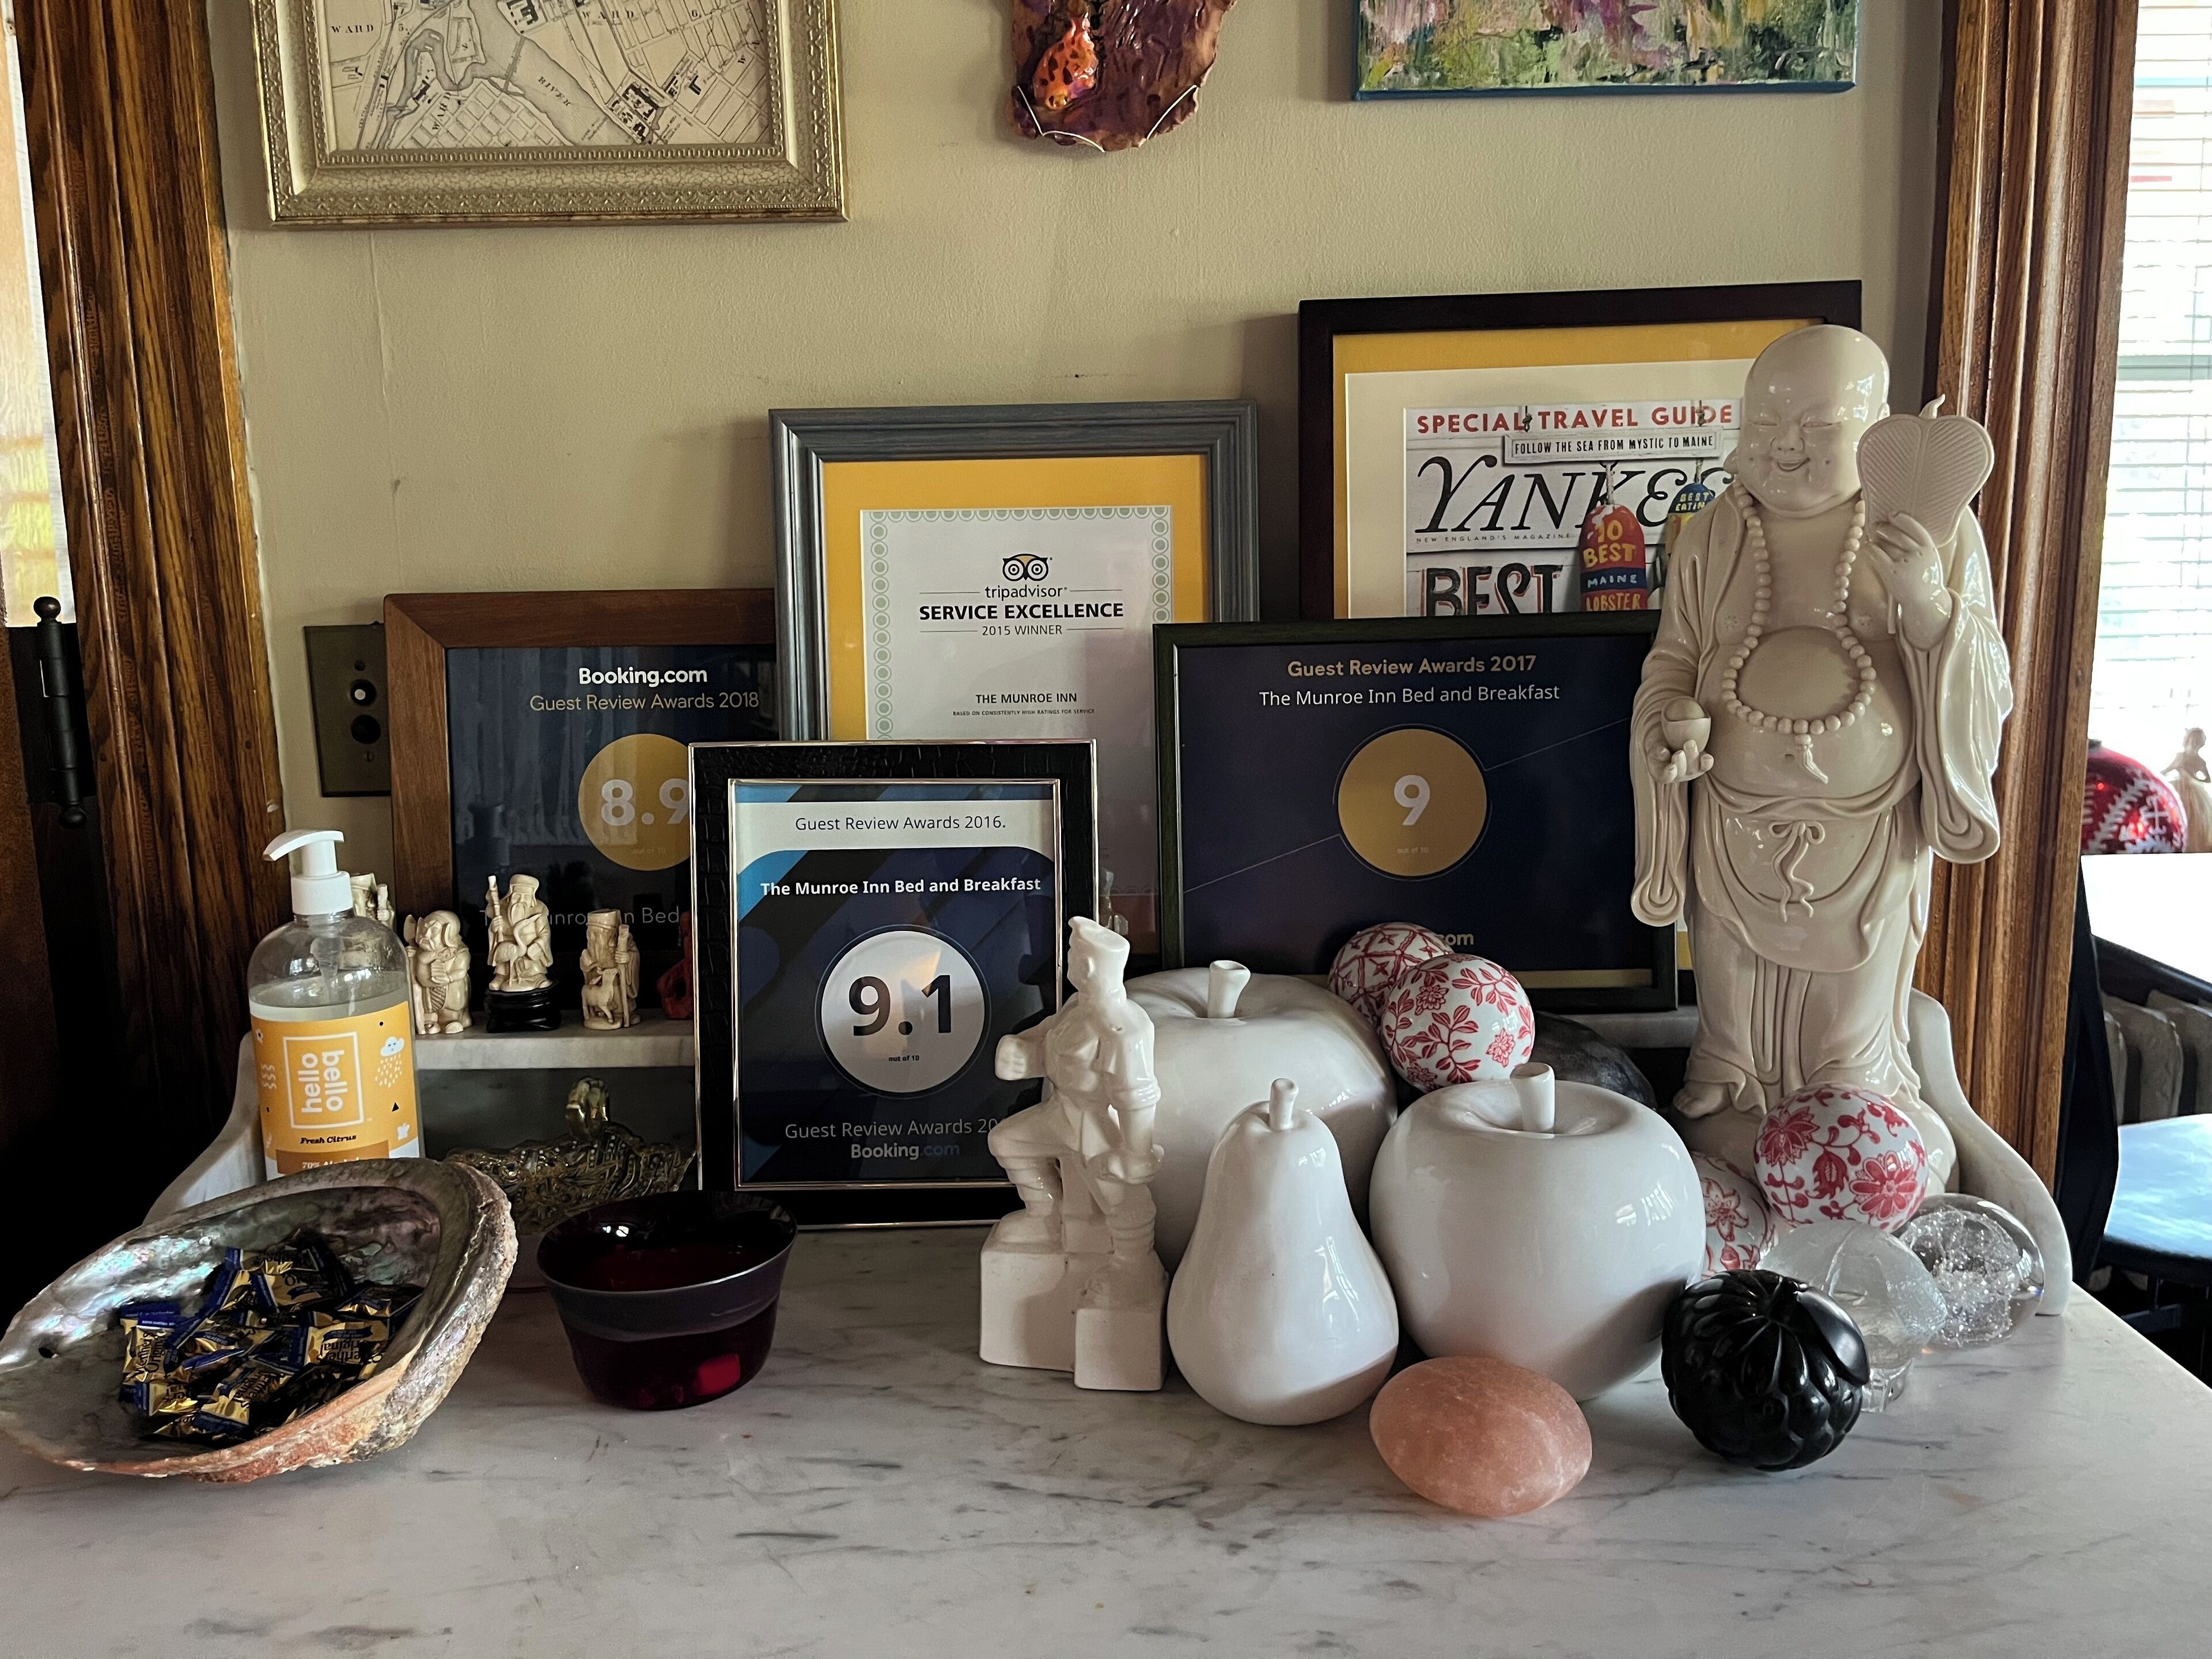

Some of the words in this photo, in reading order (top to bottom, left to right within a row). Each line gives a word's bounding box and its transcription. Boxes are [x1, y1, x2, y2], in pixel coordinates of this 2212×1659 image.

[331, 24, 374, 33] WARD
[537, 76, 572, 107] RIVER
[432, 92, 452, 130] WARD
[1417, 411, 1525, 434] SPECIAL
[1538, 408, 1638, 429] TRAVEL
[1651, 404, 1732, 426] GUIDE
[1515, 442, 1551, 454] FOLLOW
[1556, 441, 1571, 453] THE
[1577, 440, 1593, 452] SEA
[1598, 439, 1624, 451] FROM
[1628, 438, 1664, 450] MYSTIC
[1669, 437, 1679, 449] TO
[1683, 436, 1713, 448] MAINE
[1680, 492, 1709, 502] BEST
[1675, 502, 1705, 512] EATIN
[1596, 520, 1623, 543] 10
[1583, 543, 1637, 569] BEST
[1421, 563, 1563, 616] BEST
[1587, 574, 1637, 588] MAINE
[985, 585, 1063, 601] tripadvisor
[1586, 593, 1641, 611] LOBSTER
[919, 604, 998, 620] SERVICE
[1005, 603, 1124, 619] EXCELLENCE
[982, 626, 1011, 636] 2015
[1015, 624, 1062, 635] WINNER
[1287, 661, 1343, 677] Guest
[1350, 659, 1413, 675] Review
[1418, 657, 1485, 674] Awards
[1490, 655, 1536, 672] 2017
[579, 666, 707, 687] Booking.com
[530, 695, 581, 711] Guest
[587, 694, 646, 710] Review
[651, 692, 714, 709] Awards
[719, 692, 759, 707] 2018
[976, 694, 997, 703] THE
[1001, 693, 1052, 703] MUNROE
[1056, 693, 1077, 702] INN
[1260, 691, 1290, 707] The
[1296, 690, 1363, 706] Munroe
[1369, 689, 1396, 704] Inn
[1403, 687, 1434, 703] Bed
[1440, 687, 1472, 702] and
[1478, 685, 1560, 701] Breakfast
[600, 778, 690, 826] 8.9
[1393, 774, 1430, 826] 9
[796, 817, 840, 831] Guest
[846, 816, 899, 831] Review
[903, 815, 960, 830] Awards
[965, 816, 1006, 829] 2016.
[761, 882, 790, 896] The
[796, 881, 858, 895] Munroe
[863, 881, 889, 893] Inn
[895, 879, 924, 893] Bed
[929, 878, 957, 892] and
[964, 877, 1041, 891] Breakfast
[642, 907, 679, 923] Bed
[849, 974, 952, 1036] 9.1
[298, 1053, 323, 1113] hello
[322, 1050, 348, 1112] bello
[785, 1123, 836, 1139] Guest
[842, 1122, 903, 1137] Review
[907, 1119, 972, 1135] Awards
[978, 1119, 998, 1133] 20
[327, 1135, 357, 1143] Citrus
[320, 1339, 359, 1355] riginal
